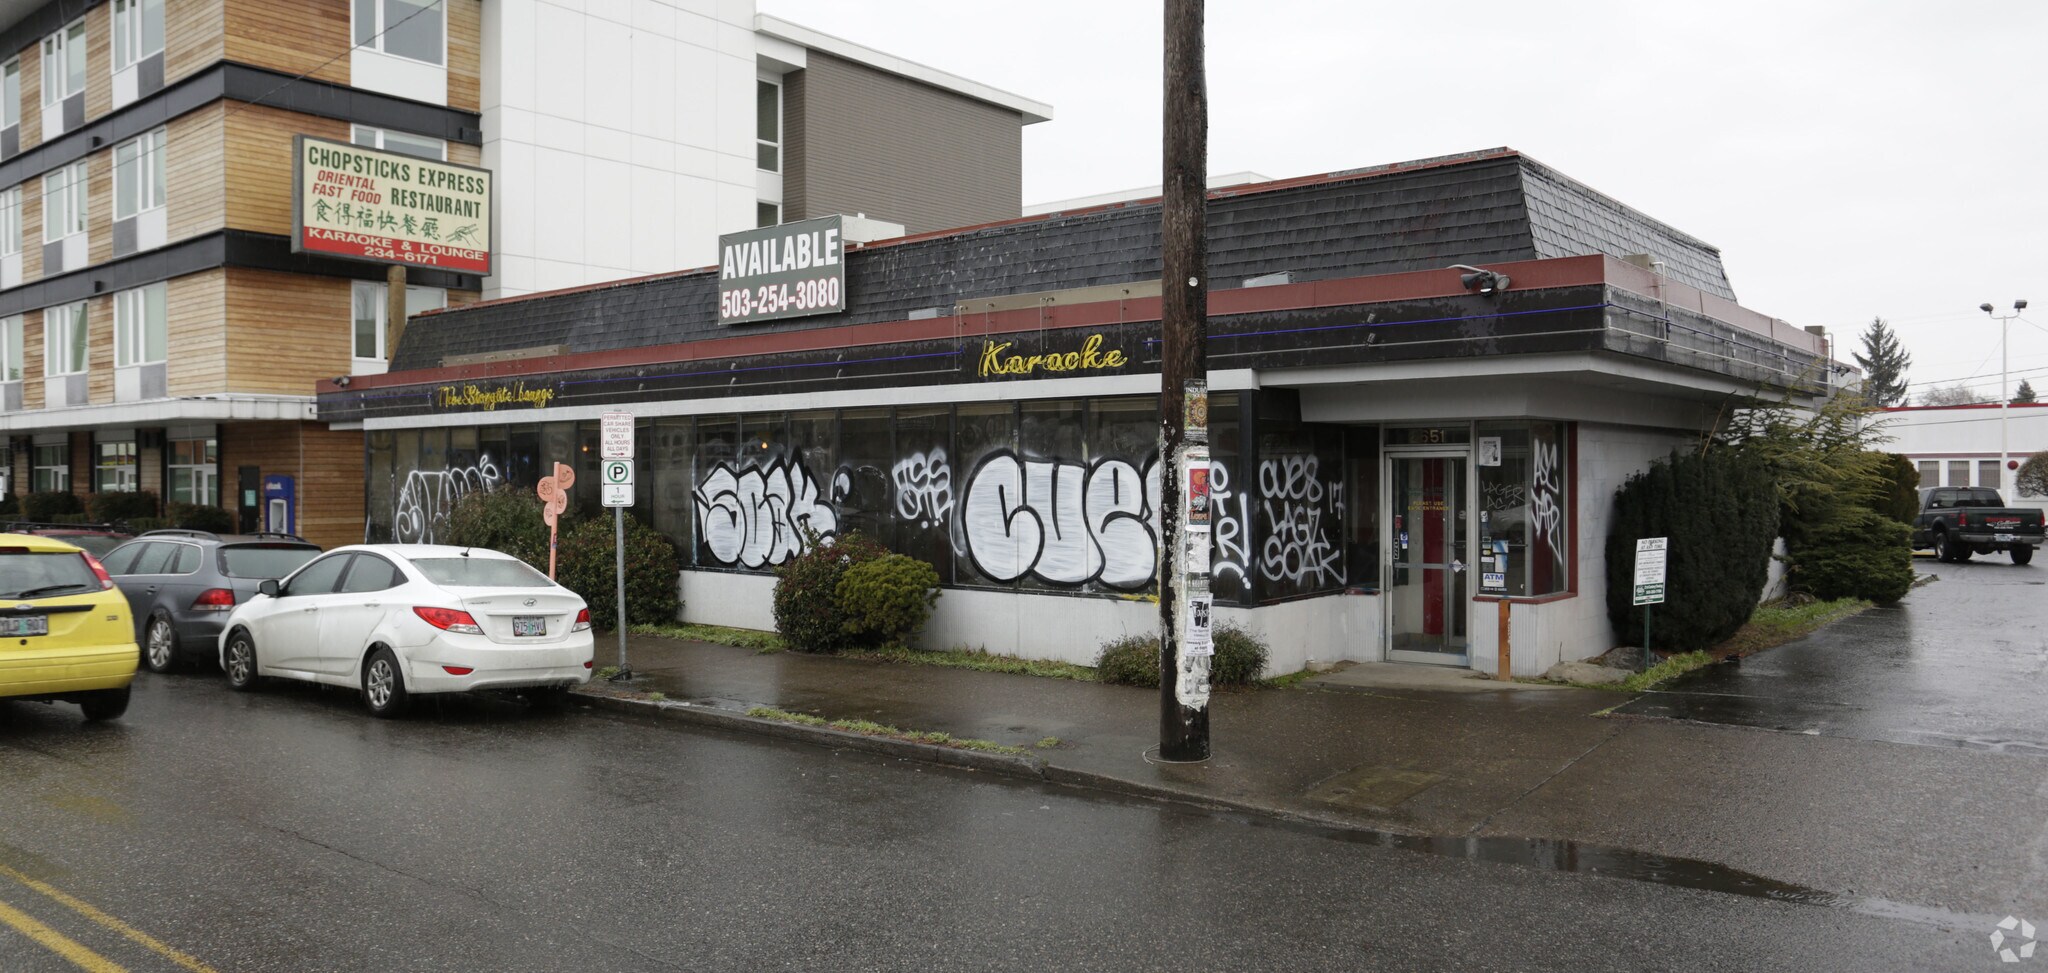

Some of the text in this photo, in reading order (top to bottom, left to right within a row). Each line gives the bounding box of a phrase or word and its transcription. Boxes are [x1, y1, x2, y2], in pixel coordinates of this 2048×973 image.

[308, 146, 484, 195] CHOPSTICKS EXPRESS
[317, 170, 375, 191] ORIENTAL
[312, 183, 382, 205] FAST FOOD
[391, 188, 481, 219] RESTAURANT
[312, 198, 441, 241] 食得福快餐廳
[308, 228, 485, 261] KARAOKE & LOUNGE
[364, 246, 437, 265] 234-6171
[722, 228, 838, 280] AVAILABLE
[722, 277, 839, 318] 503-254-3080
[978, 334, 1128, 377] Karaoke
[614, 466, 624, 479] P
[1484, 573, 1504, 581] ATM
